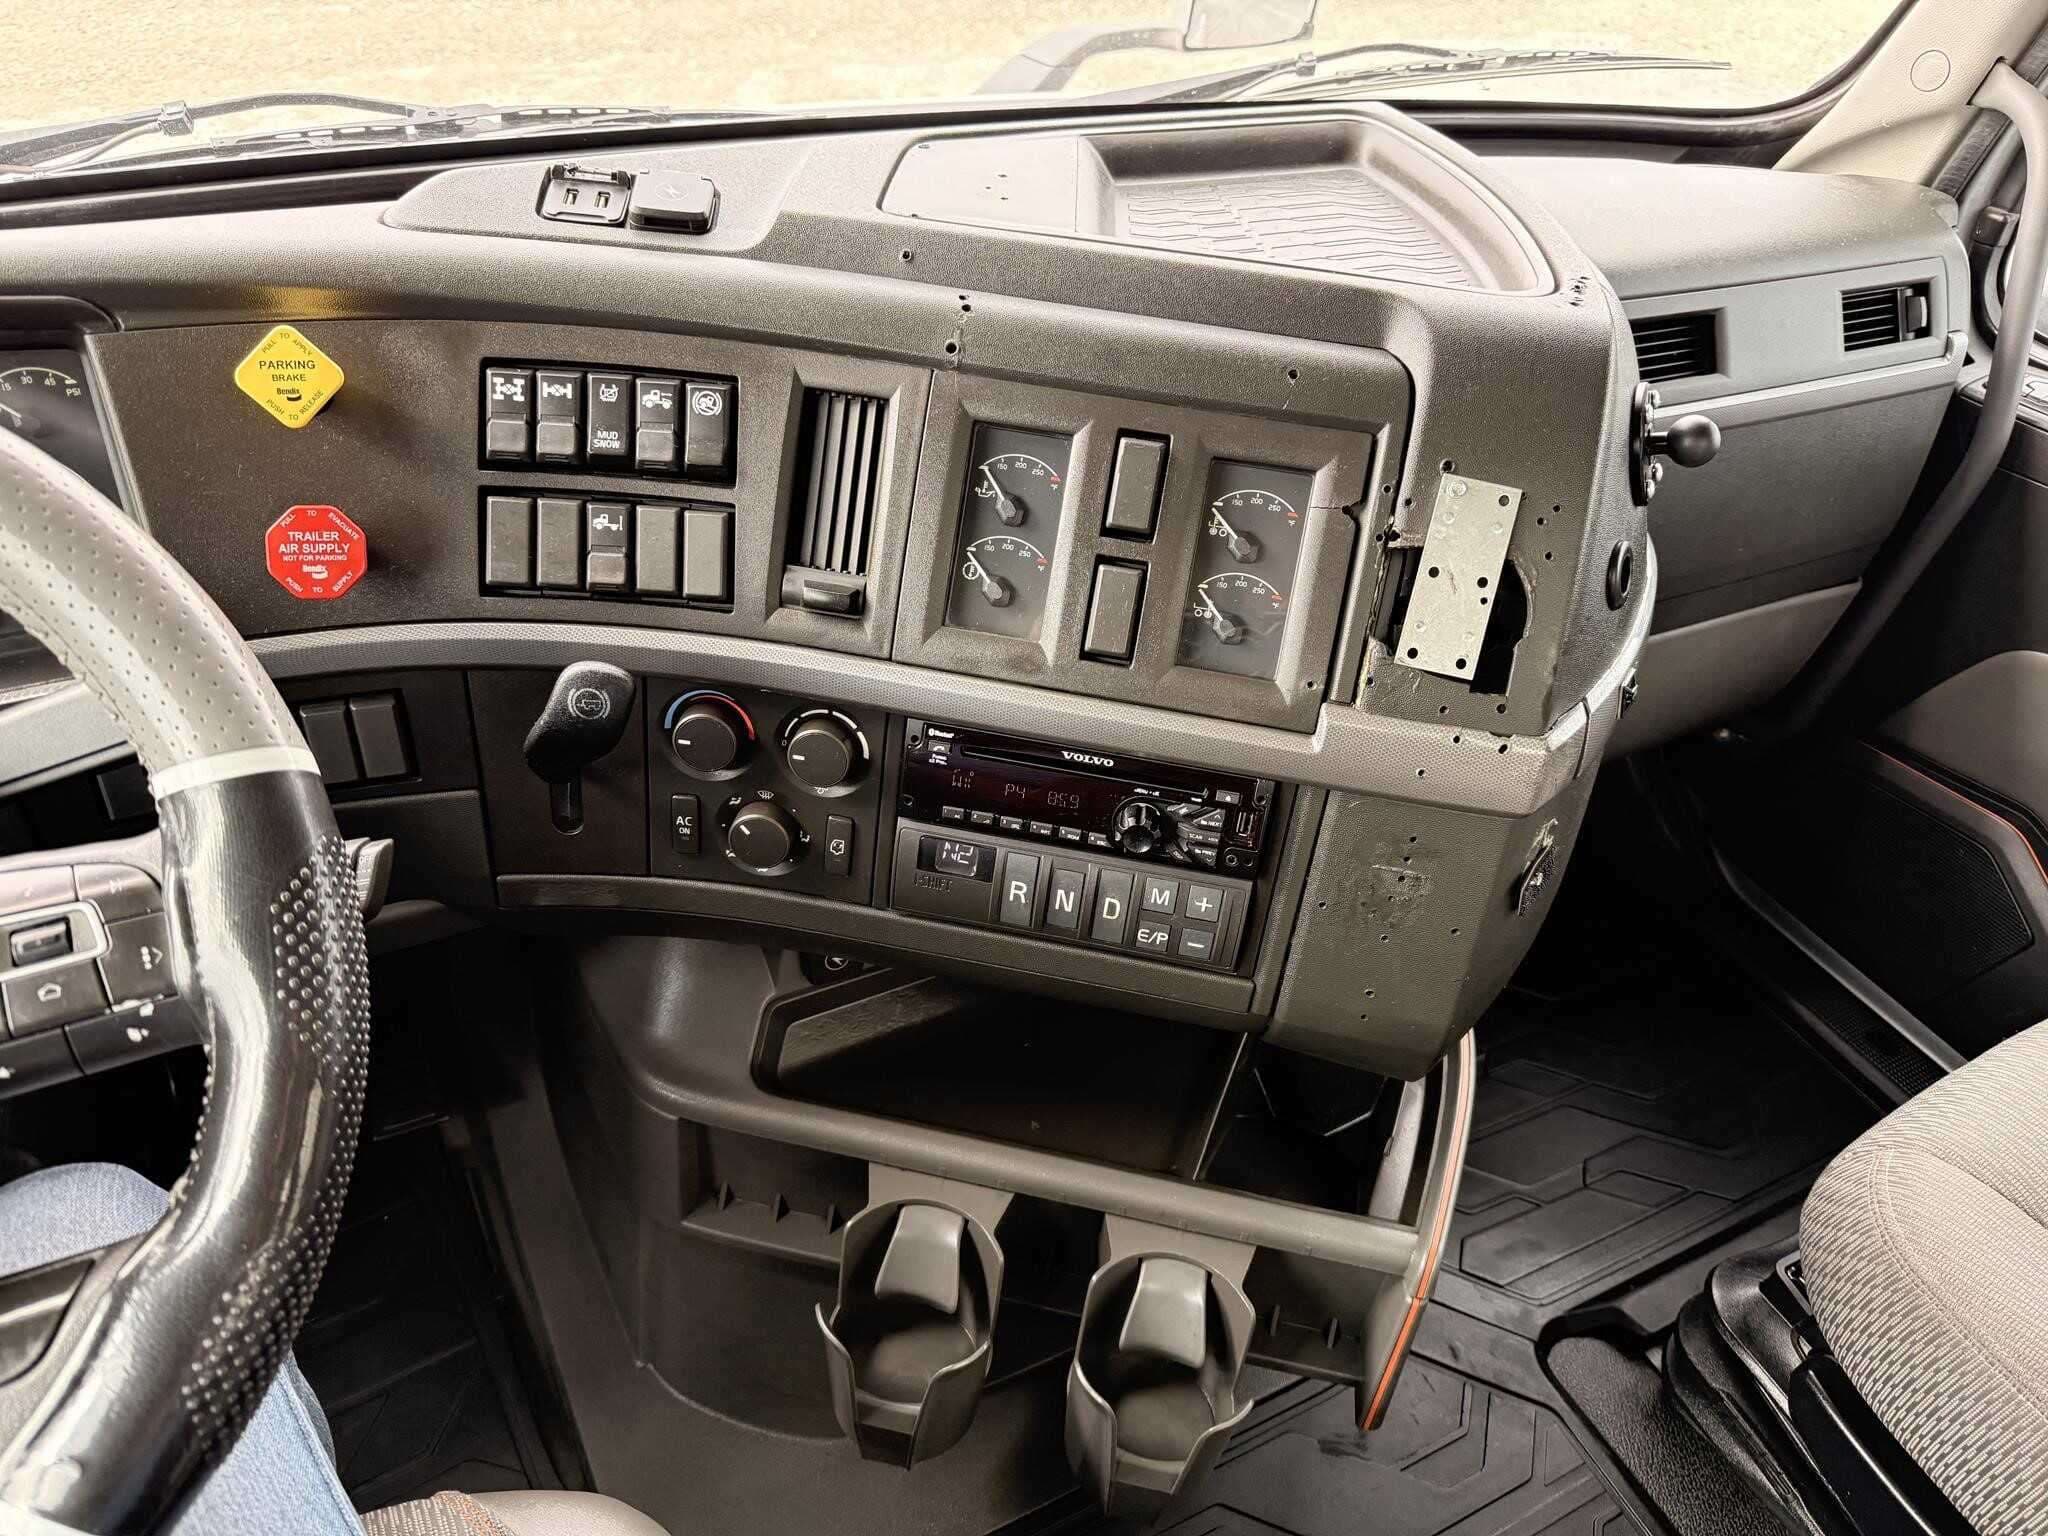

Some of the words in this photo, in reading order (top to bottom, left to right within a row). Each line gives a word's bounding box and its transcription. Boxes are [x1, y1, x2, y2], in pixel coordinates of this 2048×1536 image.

[292, 339, 313, 356] APPLY
[258, 359, 316, 370] PARKING
[20, 375, 33, 385] 30
[44, 377, 56, 386] 45
[271, 373, 306, 382] BRAKE
[65, 387, 81, 397] PSI
[276, 387, 300, 396] Bendix
[266, 398, 285, 415] PUSH
[298, 390, 324, 415] RELEASE
[597, 430, 618, 440] MUD
[592, 438, 620, 449] SNOW
[1014, 461, 1027, 469] 200
[1031, 468, 1044, 477] 250
[1250, 497, 1263, 505] 200
[1267, 504, 1281, 512] 250
[327, 511, 360, 540] EVACUATE
[287, 531, 340, 542] TRAILER
[278, 543, 299, 554] AIR
[302, 543, 350, 554] SUPPLY
[984, 544, 995, 552] 150
[1001, 543, 1014, 551] 200
[1018, 550, 1031, 558] 250
[282, 554, 298, 562] NOT
[285, 576, 304, 593] PUSH
[332, 570, 353, 592] SUPPLY
[1234, 580, 1248, 588] 200
[1252, 586, 1266, 595] 250
[1060, 750, 1114, 767] VOLVO
[675, 815, 693, 826] AC
[678, 826, 691, 835] ON
[1008, 880, 1028, 904] R
[1149, 887, 1171, 906] M
[1054, 888, 1075, 912] N
[1101, 897, 1121, 920] D
[1137, 928, 1169, 946] E/P
